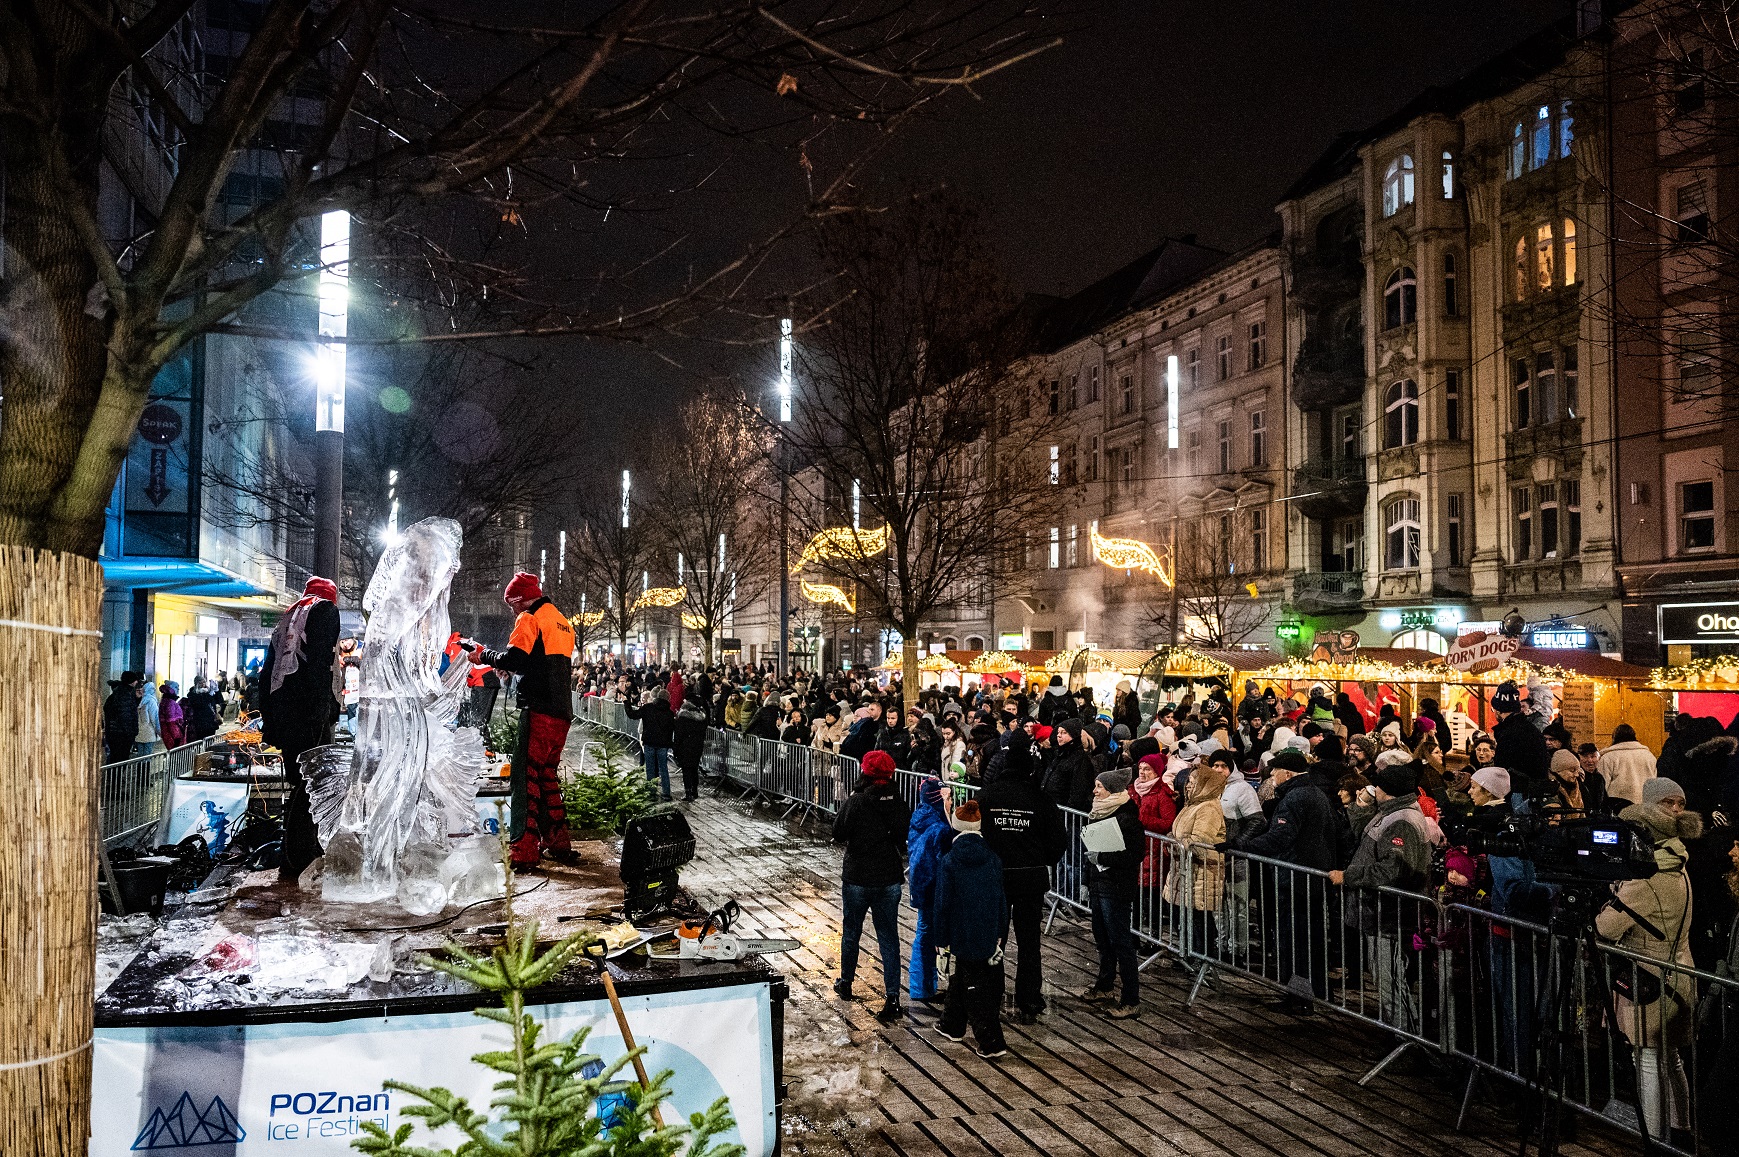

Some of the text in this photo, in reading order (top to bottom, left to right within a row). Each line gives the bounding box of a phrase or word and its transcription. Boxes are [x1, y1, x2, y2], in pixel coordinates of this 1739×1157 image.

[556, 622, 571, 634] STIHL
[1445, 638, 1517, 665] CORN DOGS
[994, 817, 1030, 827] ICE TEAM
[1508, 824, 1515, 833] 9
[267, 1120, 299, 1141] Ice
